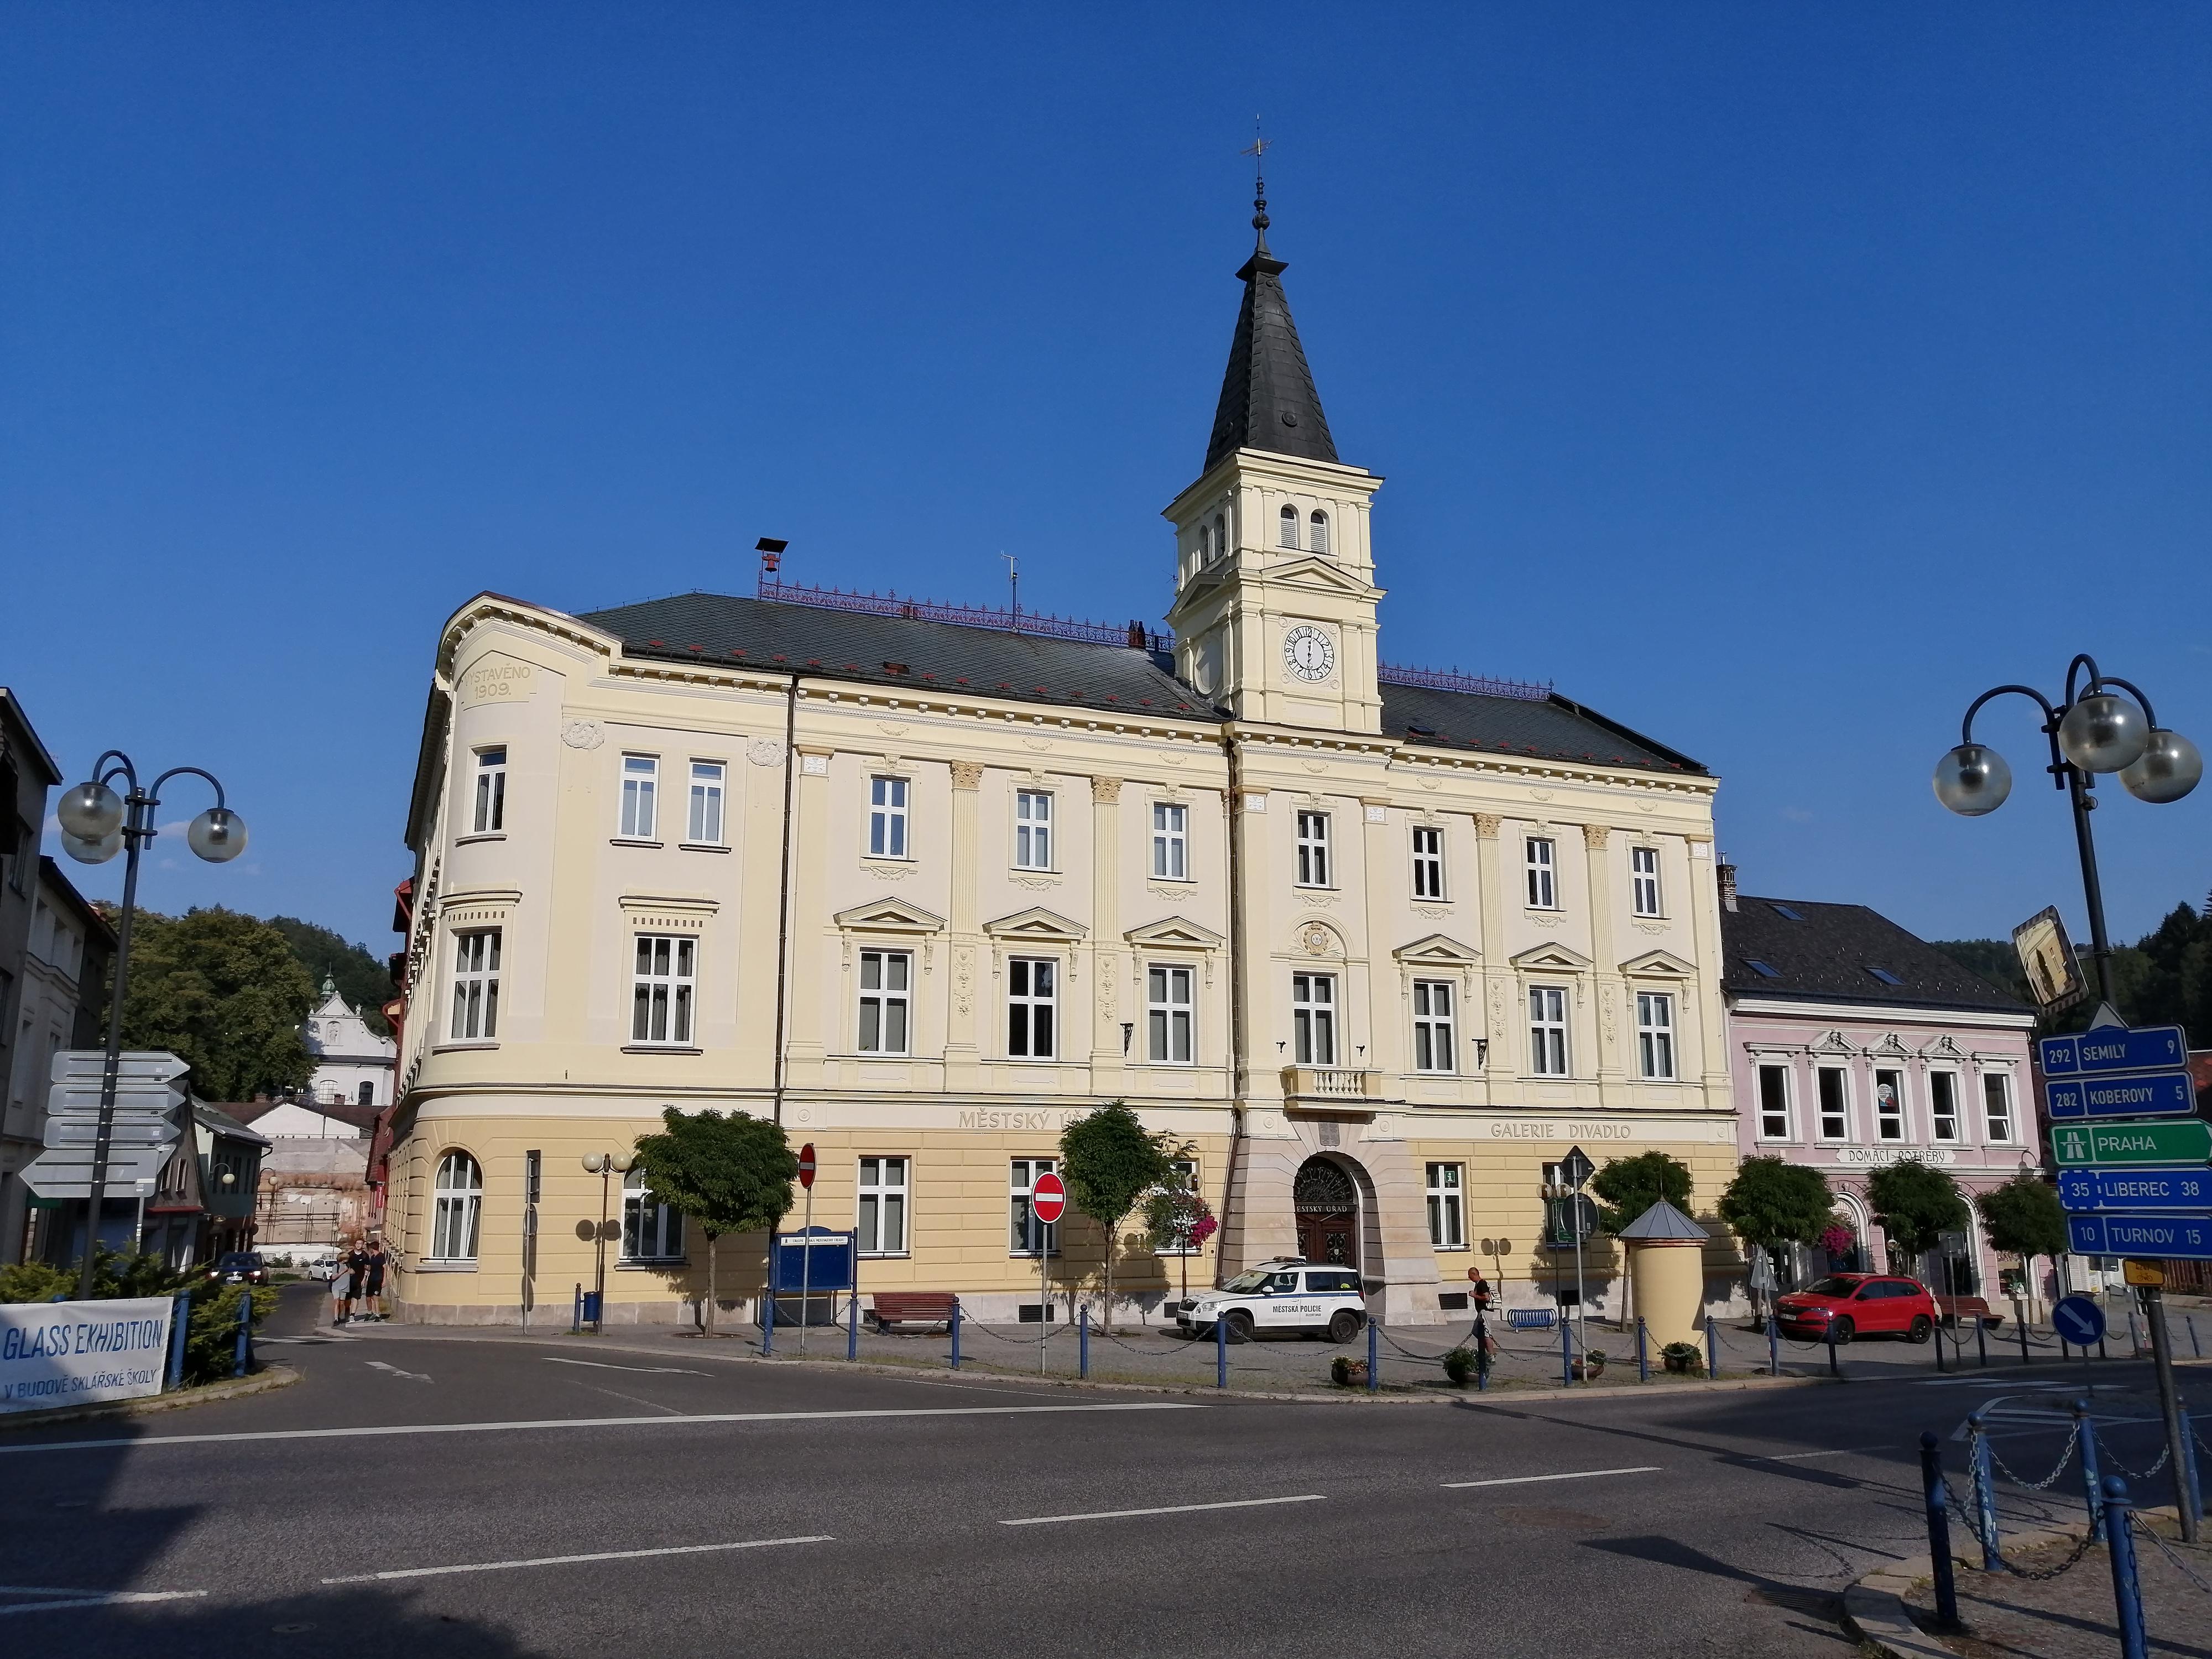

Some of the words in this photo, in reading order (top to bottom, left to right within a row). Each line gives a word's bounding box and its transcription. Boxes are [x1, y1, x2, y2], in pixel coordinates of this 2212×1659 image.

[1296, 628, 1302, 639] 11
[1306, 627, 1312, 637] 12
[1287, 636, 1296, 645] 10
[1297, 665, 1304, 675] 7
[1307, 669, 1313, 679] 6
[1316, 668, 1323, 678] 5
[2048, 1048, 2071, 1063] 292
[2083, 1044, 2126, 1061] SEMILY
[2167, 1040, 2175, 1054] 9
[2056, 1093, 2078, 1107] 282
[2089, 1087, 2153, 1105] KOBEROVY
[2176, 1086, 2184, 1100] 5
[959, 1107, 1051, 1129] MĚSTSKÝ
[1491, 1123, 1554, 1138] GALERIE
[1568, 1124, 1632, 1139] DIVADLO
[2098, 1136, 2157, 1151] PRAHA
[2072, 1182, 2090, 1197] 35
[2105, 1182, 2170, 1197] LIBEREC
[2180, 1181, 2200, 1197] 38
[2080, 1227, 2095, 1241] 10
[2111, 1228, 2174, 1244] TURNOV
[2186, 1229, 2201, 1245] 15
[3, 1324, 71, 1361] GLASS
[4, 1384, 13, 1399] V
[18, 1375, 69, 1398] BUDOVĚ
[71, 1369, 124, 1391] SKLÁŘSKÉ
[127, 1368, 158, 1385] ŠKOLY
